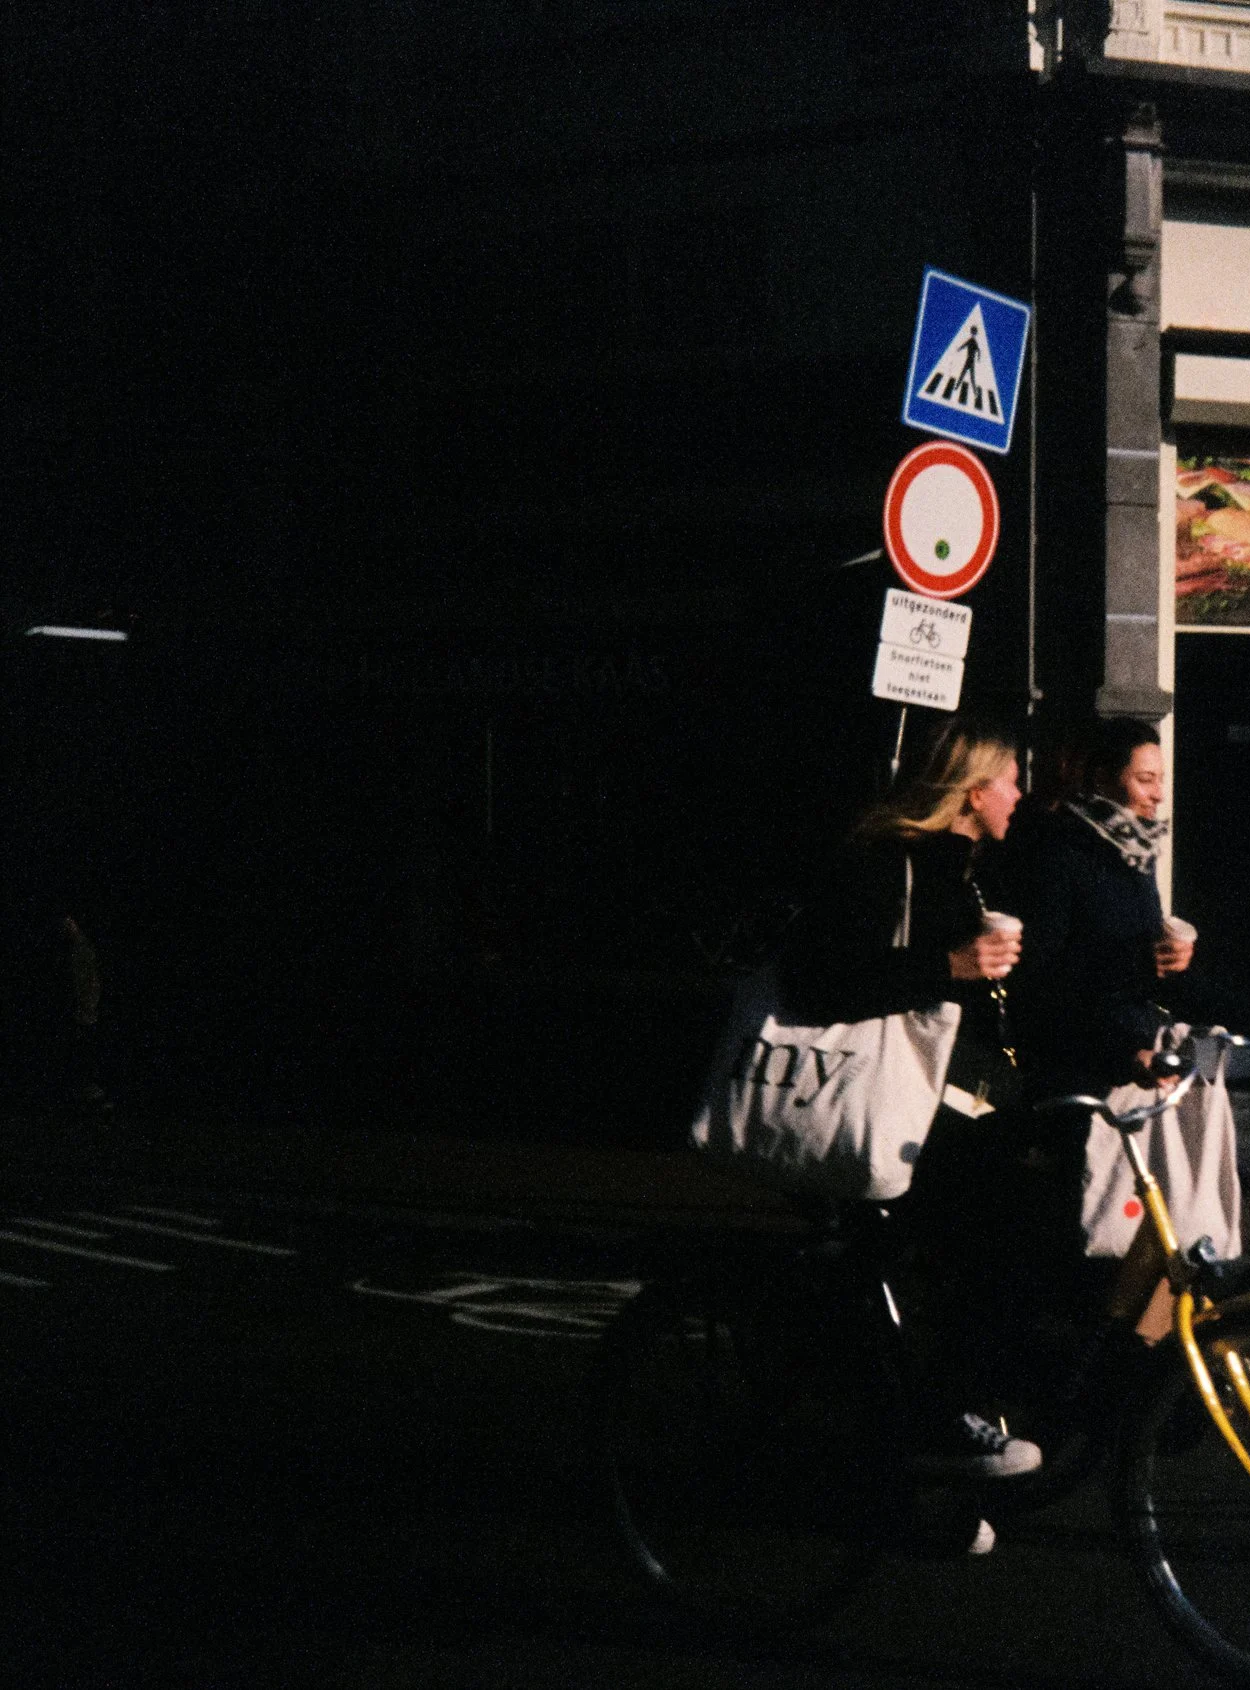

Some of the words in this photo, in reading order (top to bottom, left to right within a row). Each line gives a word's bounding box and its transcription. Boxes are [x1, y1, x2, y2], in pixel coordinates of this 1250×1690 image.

[892, 596, 967, 623] uitgezonderd
[908, 672, 931, 682] niet
[887, 683, 947, 702] toegestaan
[730, 1037, 853, 1107] my
